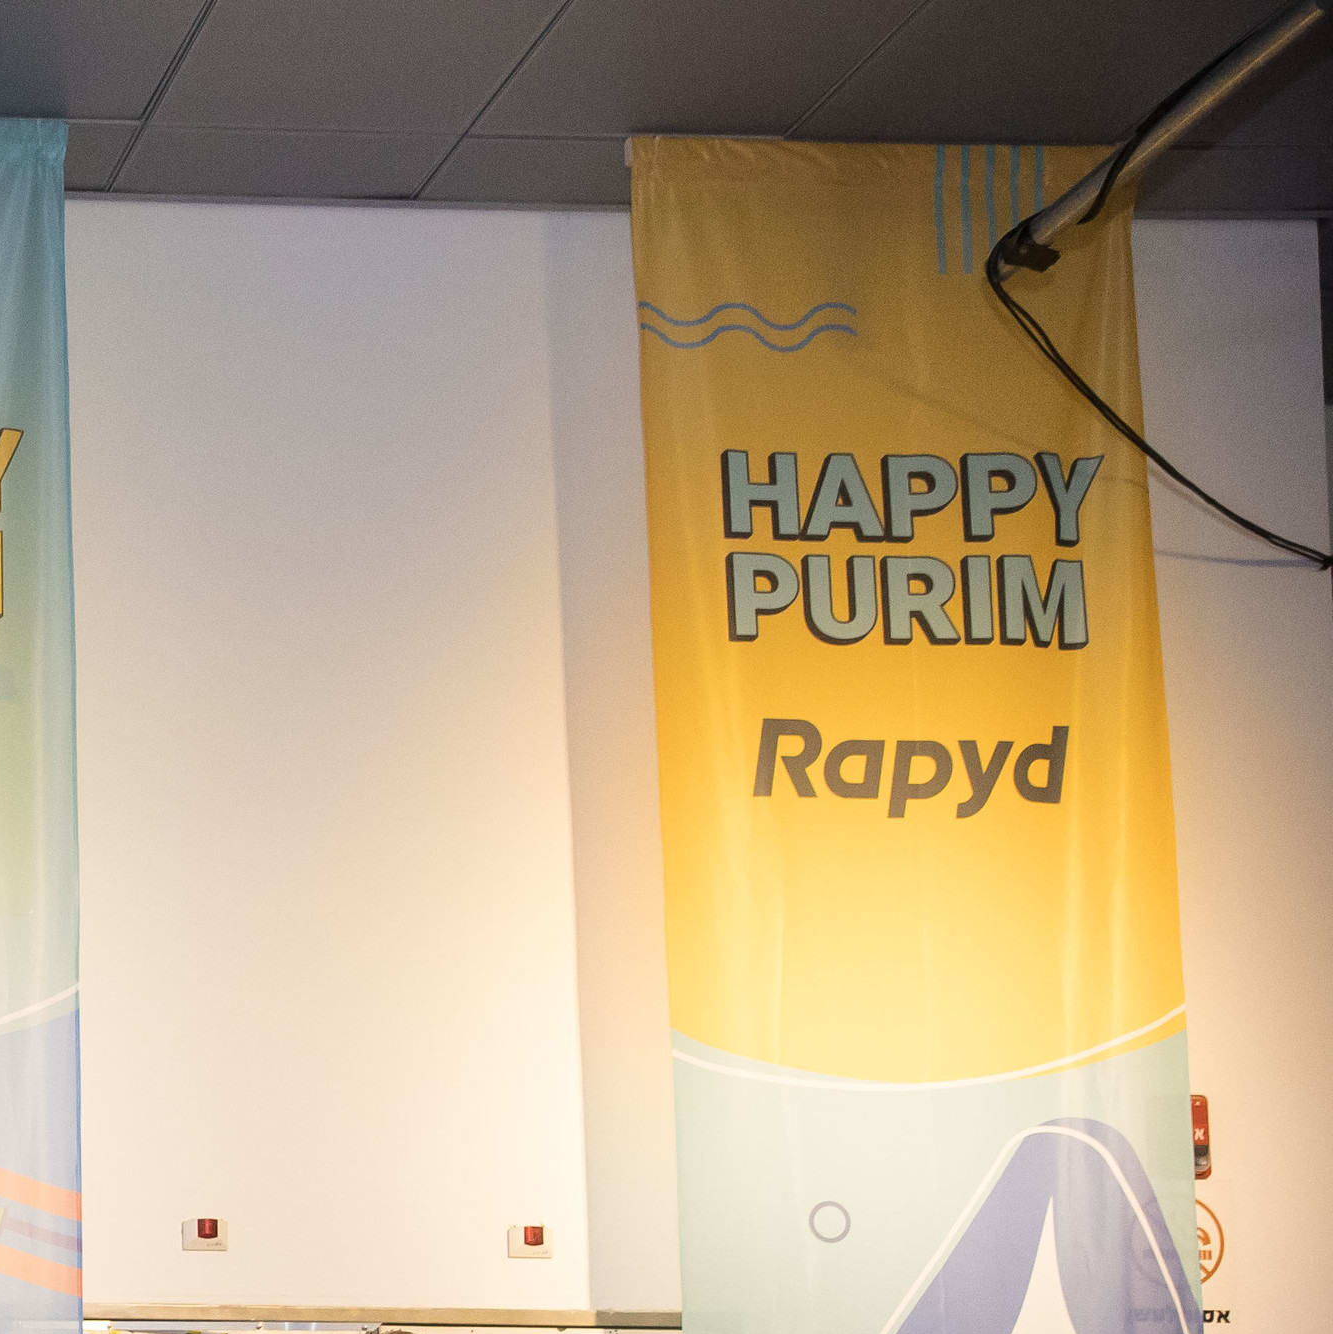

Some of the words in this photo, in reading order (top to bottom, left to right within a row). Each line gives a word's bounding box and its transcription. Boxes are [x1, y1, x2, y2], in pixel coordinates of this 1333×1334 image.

[720, 449, 1105, 548] HAPPY
[725, 551, 1089, 650] PURIM
[753, 718, 1070, 819] Rapyd
